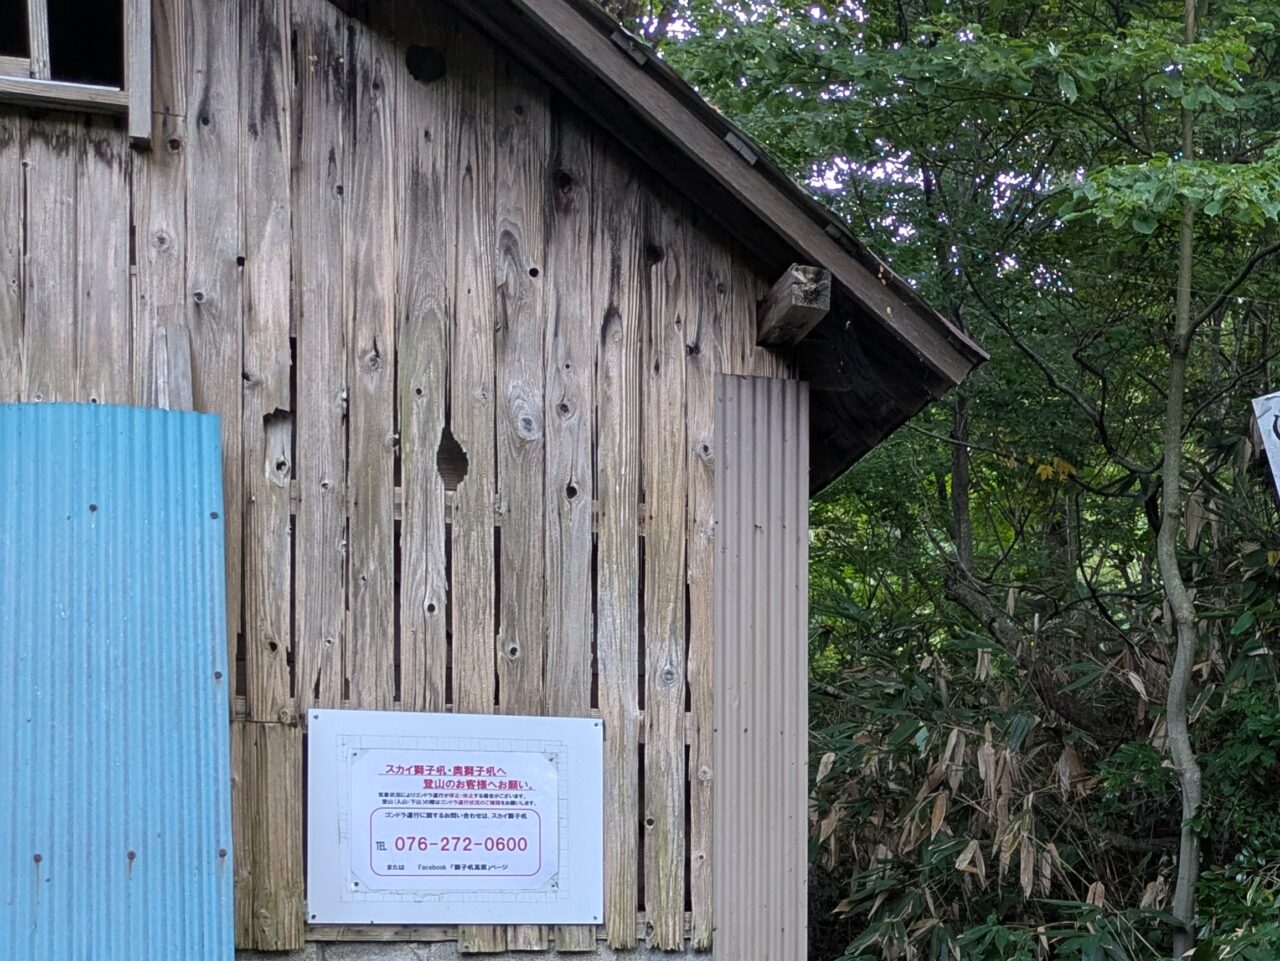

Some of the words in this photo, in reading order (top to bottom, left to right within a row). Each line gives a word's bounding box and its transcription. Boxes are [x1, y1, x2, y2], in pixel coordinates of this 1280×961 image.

[385, 764, 507, 777] スカイ獅子吼・奥獅子吼へ
[423, 778, 533, 790] 登山のお客様へお願い。
[394, 836, 528, 852] 076-272-0600
[417, 863, 447, 871] Facebook
